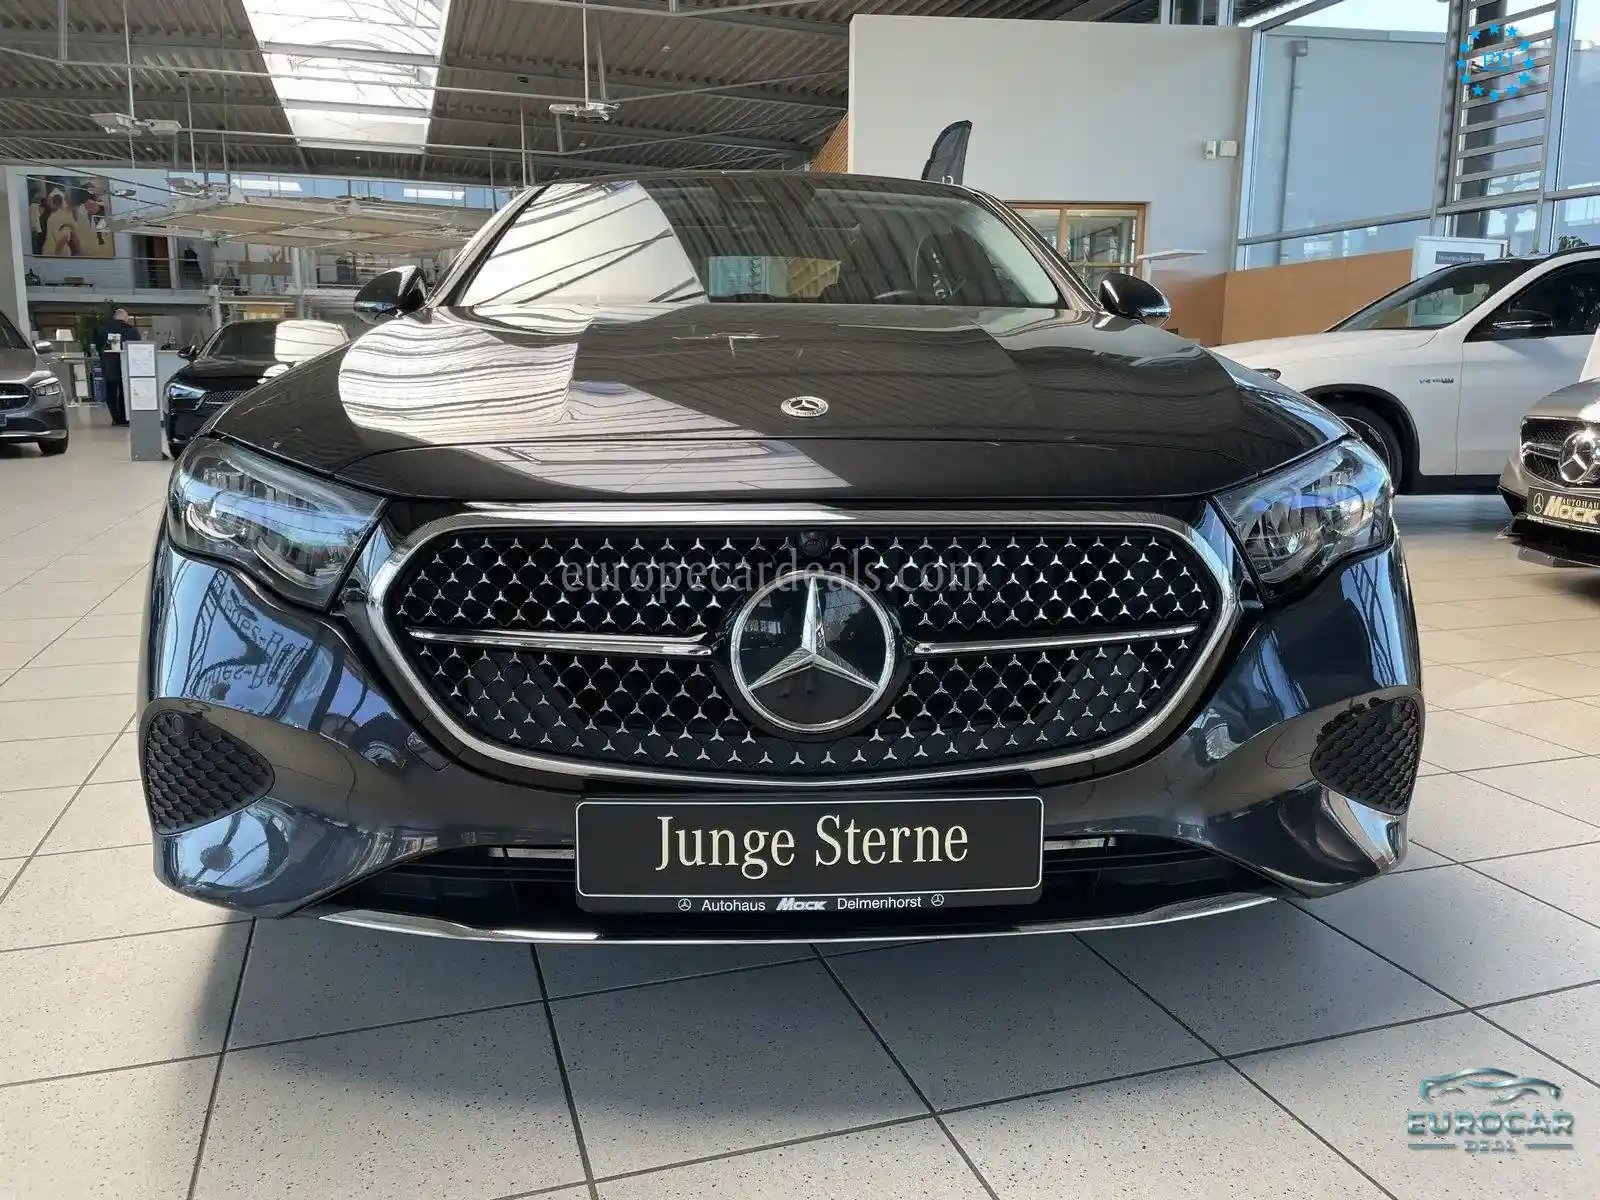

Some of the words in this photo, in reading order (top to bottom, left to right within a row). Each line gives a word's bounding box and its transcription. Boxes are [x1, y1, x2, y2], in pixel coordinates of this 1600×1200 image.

[655, 815, 795, 880] Junge
[815, 814, 969, 867] Sterne
[701, 899, 766, 911] Autohaus
[836, 896, 922, 910] Delmenhorst
